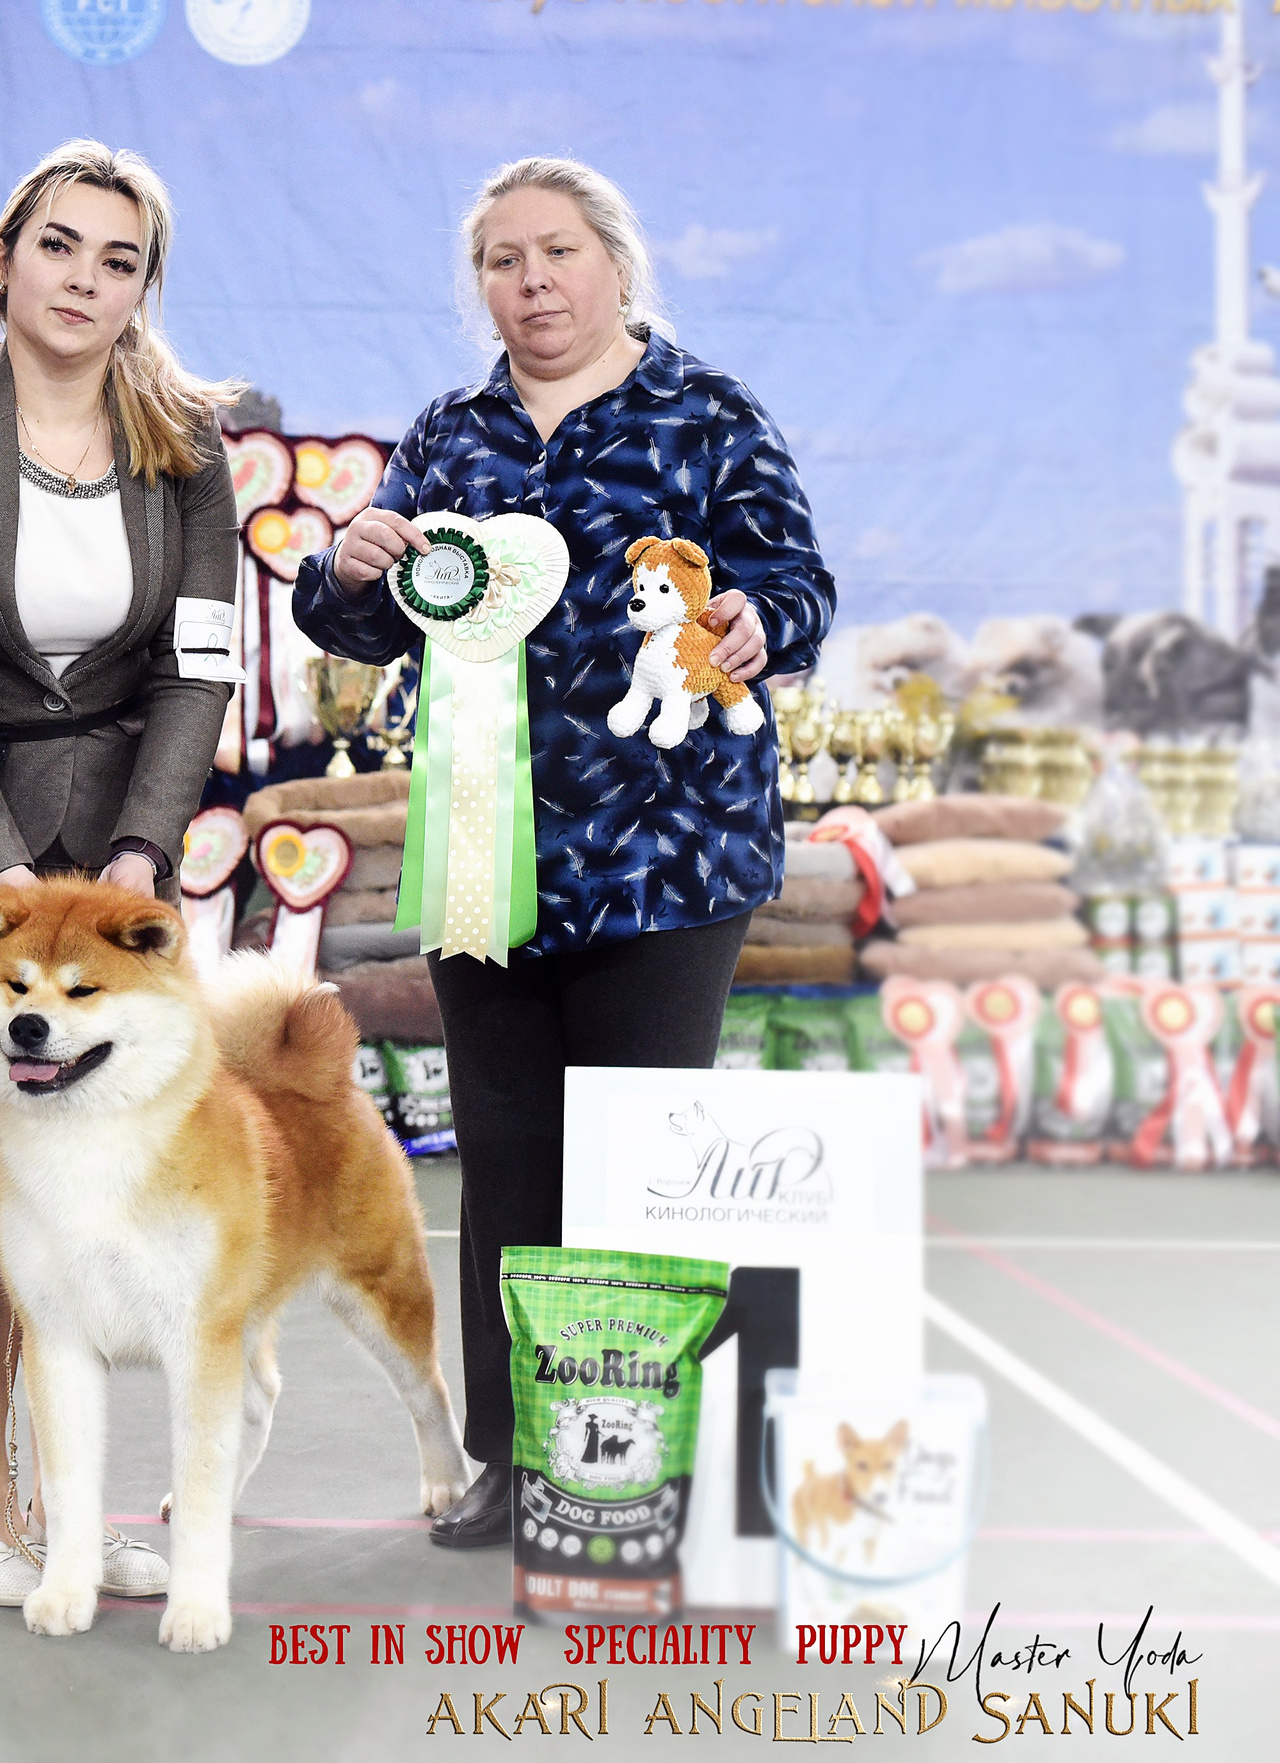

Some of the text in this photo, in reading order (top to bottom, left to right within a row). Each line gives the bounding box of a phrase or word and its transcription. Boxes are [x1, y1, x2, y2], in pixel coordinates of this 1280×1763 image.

[452, 548, 470, 579] ВЫСТАВКА
[778, 1190, 828, 1205] КЛУБ
[645, 1205, 828, 1223] КИНОЛОГИЧЕСКИЙ
[560, 1318, 670, 1348] SUPER PREMIUM
[534, 1344, 681, 1400] ZooRing
[699, 1267, 800, 1538] 1
[601, 1419, 633, 1431] ZooRing
[554, 1499, 651, 1525] DOG FOOD
[525, 1575, 563, 1597] DULT
[568, 1581, 600, 1599] DOG
